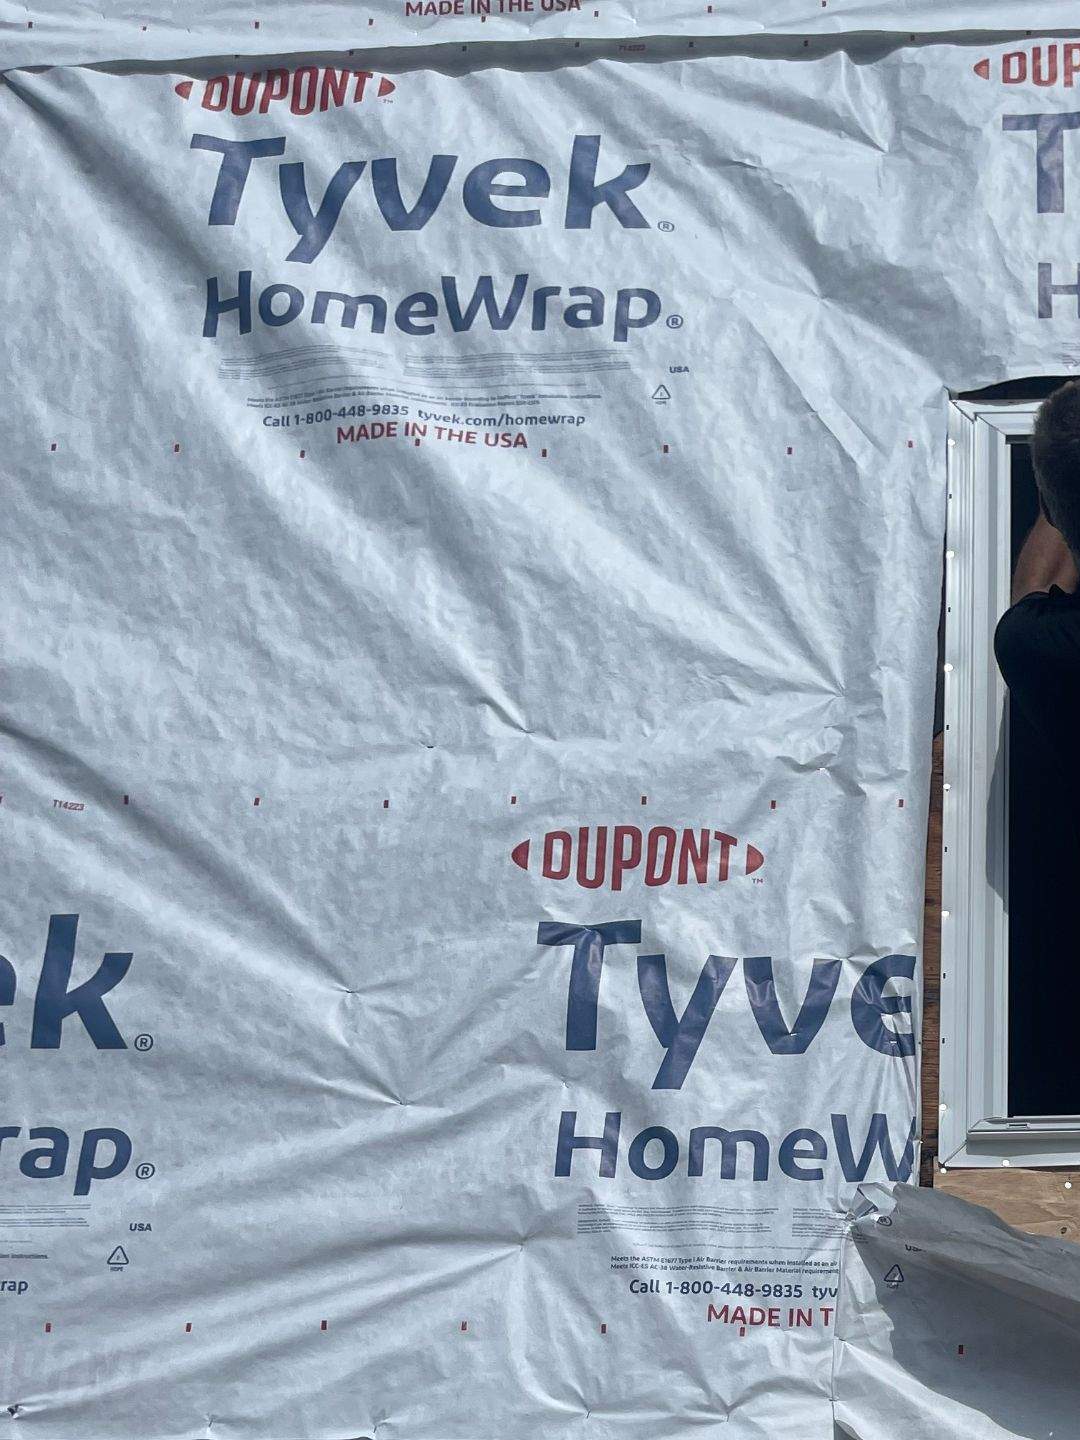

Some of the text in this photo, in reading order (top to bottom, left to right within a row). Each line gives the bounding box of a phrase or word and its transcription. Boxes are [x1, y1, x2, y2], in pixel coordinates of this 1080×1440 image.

[405, 0, 464, 16] MADE
[471, 0, 491, 14] IN
[201, 66, 374, 116] DUPONT
[263, 405, 586, 428] Call 1-800-448-9835 tyvek.com/homewrap
[337, 421, 528, 449] MADE IN THE USA
[541, 825, 740, 892] DUPONT
[129, 1223, 152, 1232] USA
[629, 1280, 660, 1294] Call
[665, 1281, 803, 1298] 1-800-448-9835
[707, 1304, 781, 1327] MADE
[788, 1308, 812, 1327] IN
